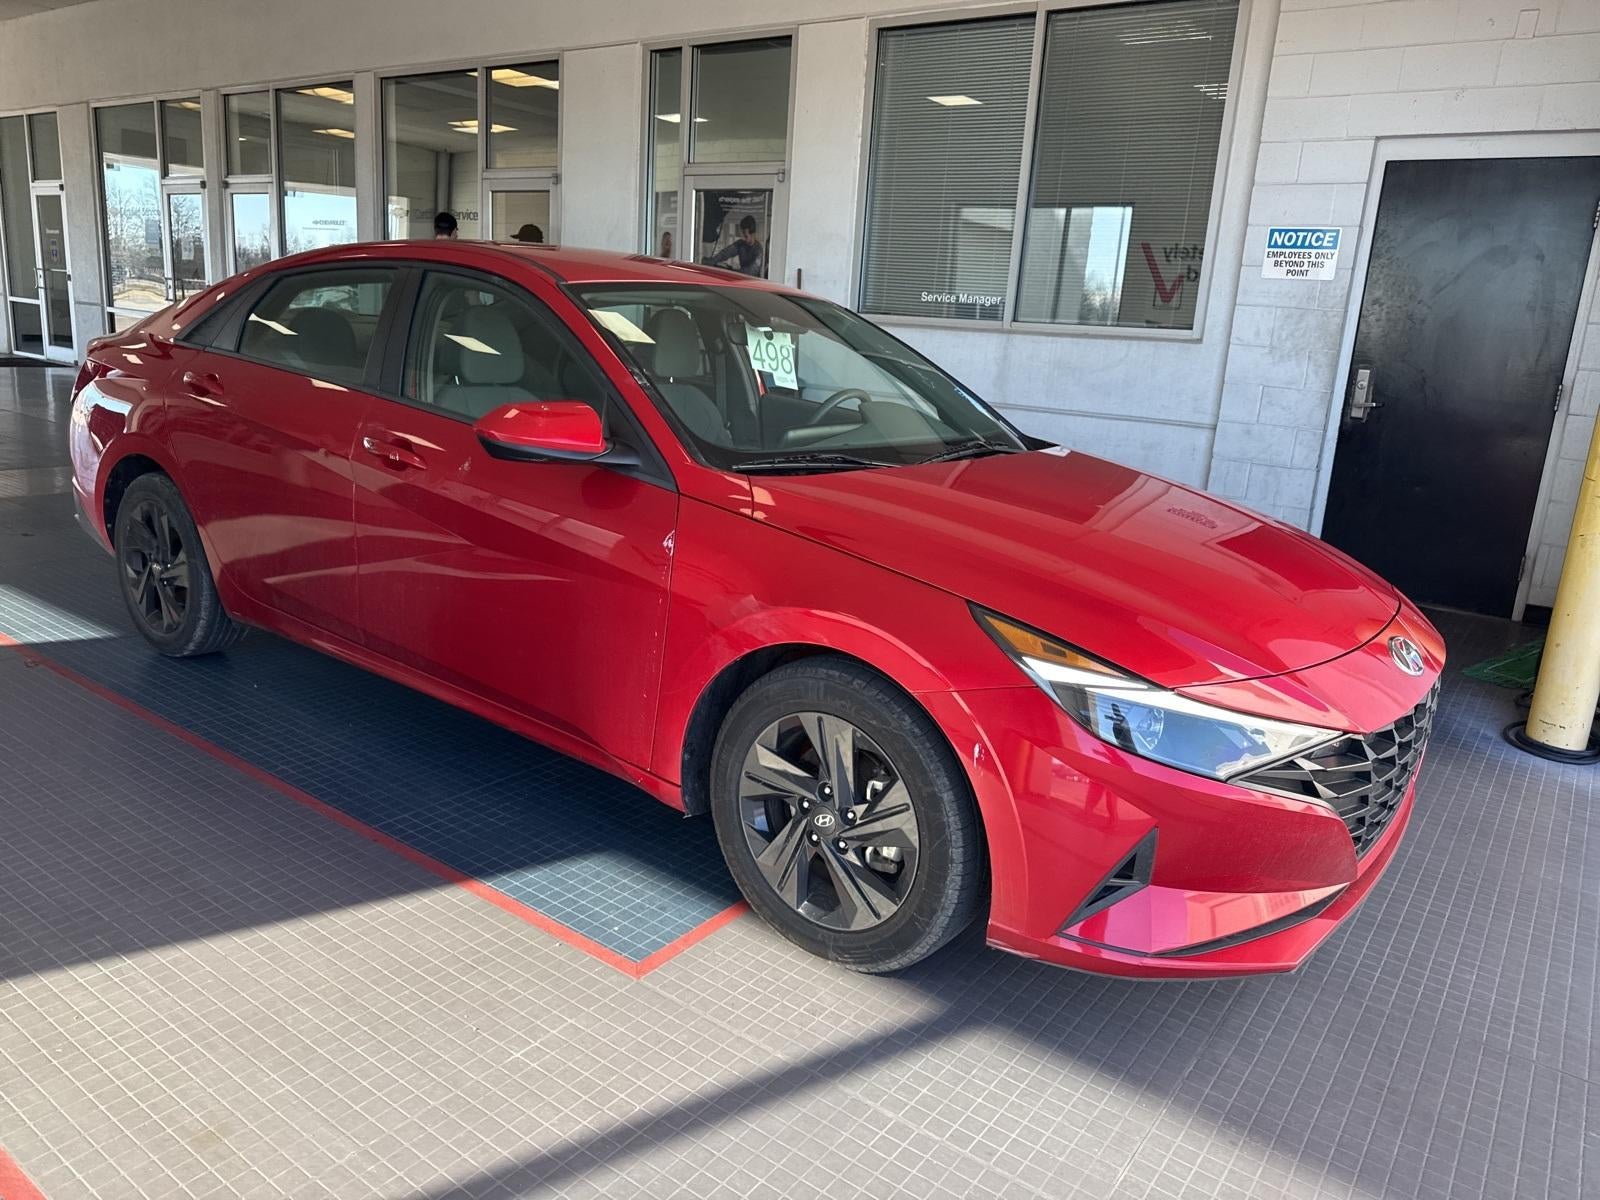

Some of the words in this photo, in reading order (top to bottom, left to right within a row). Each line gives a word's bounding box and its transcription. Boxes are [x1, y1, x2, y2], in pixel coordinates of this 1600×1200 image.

[1270, 231, 1337, 247] NOTICE
[1266, 250, 1312, 260] EMPLOYEES
[1314, 251, 1335, 260] ONLY
[1273, 260, 1305, 268] BEYOND
[1307, 260, 1325, 269] THIS
[1286, 269, 1309, 277] POINT
[920, 291, 957, 303] Service
[959, 293, 1002, 307] Manager
[753, 340, 793, 375] 498
